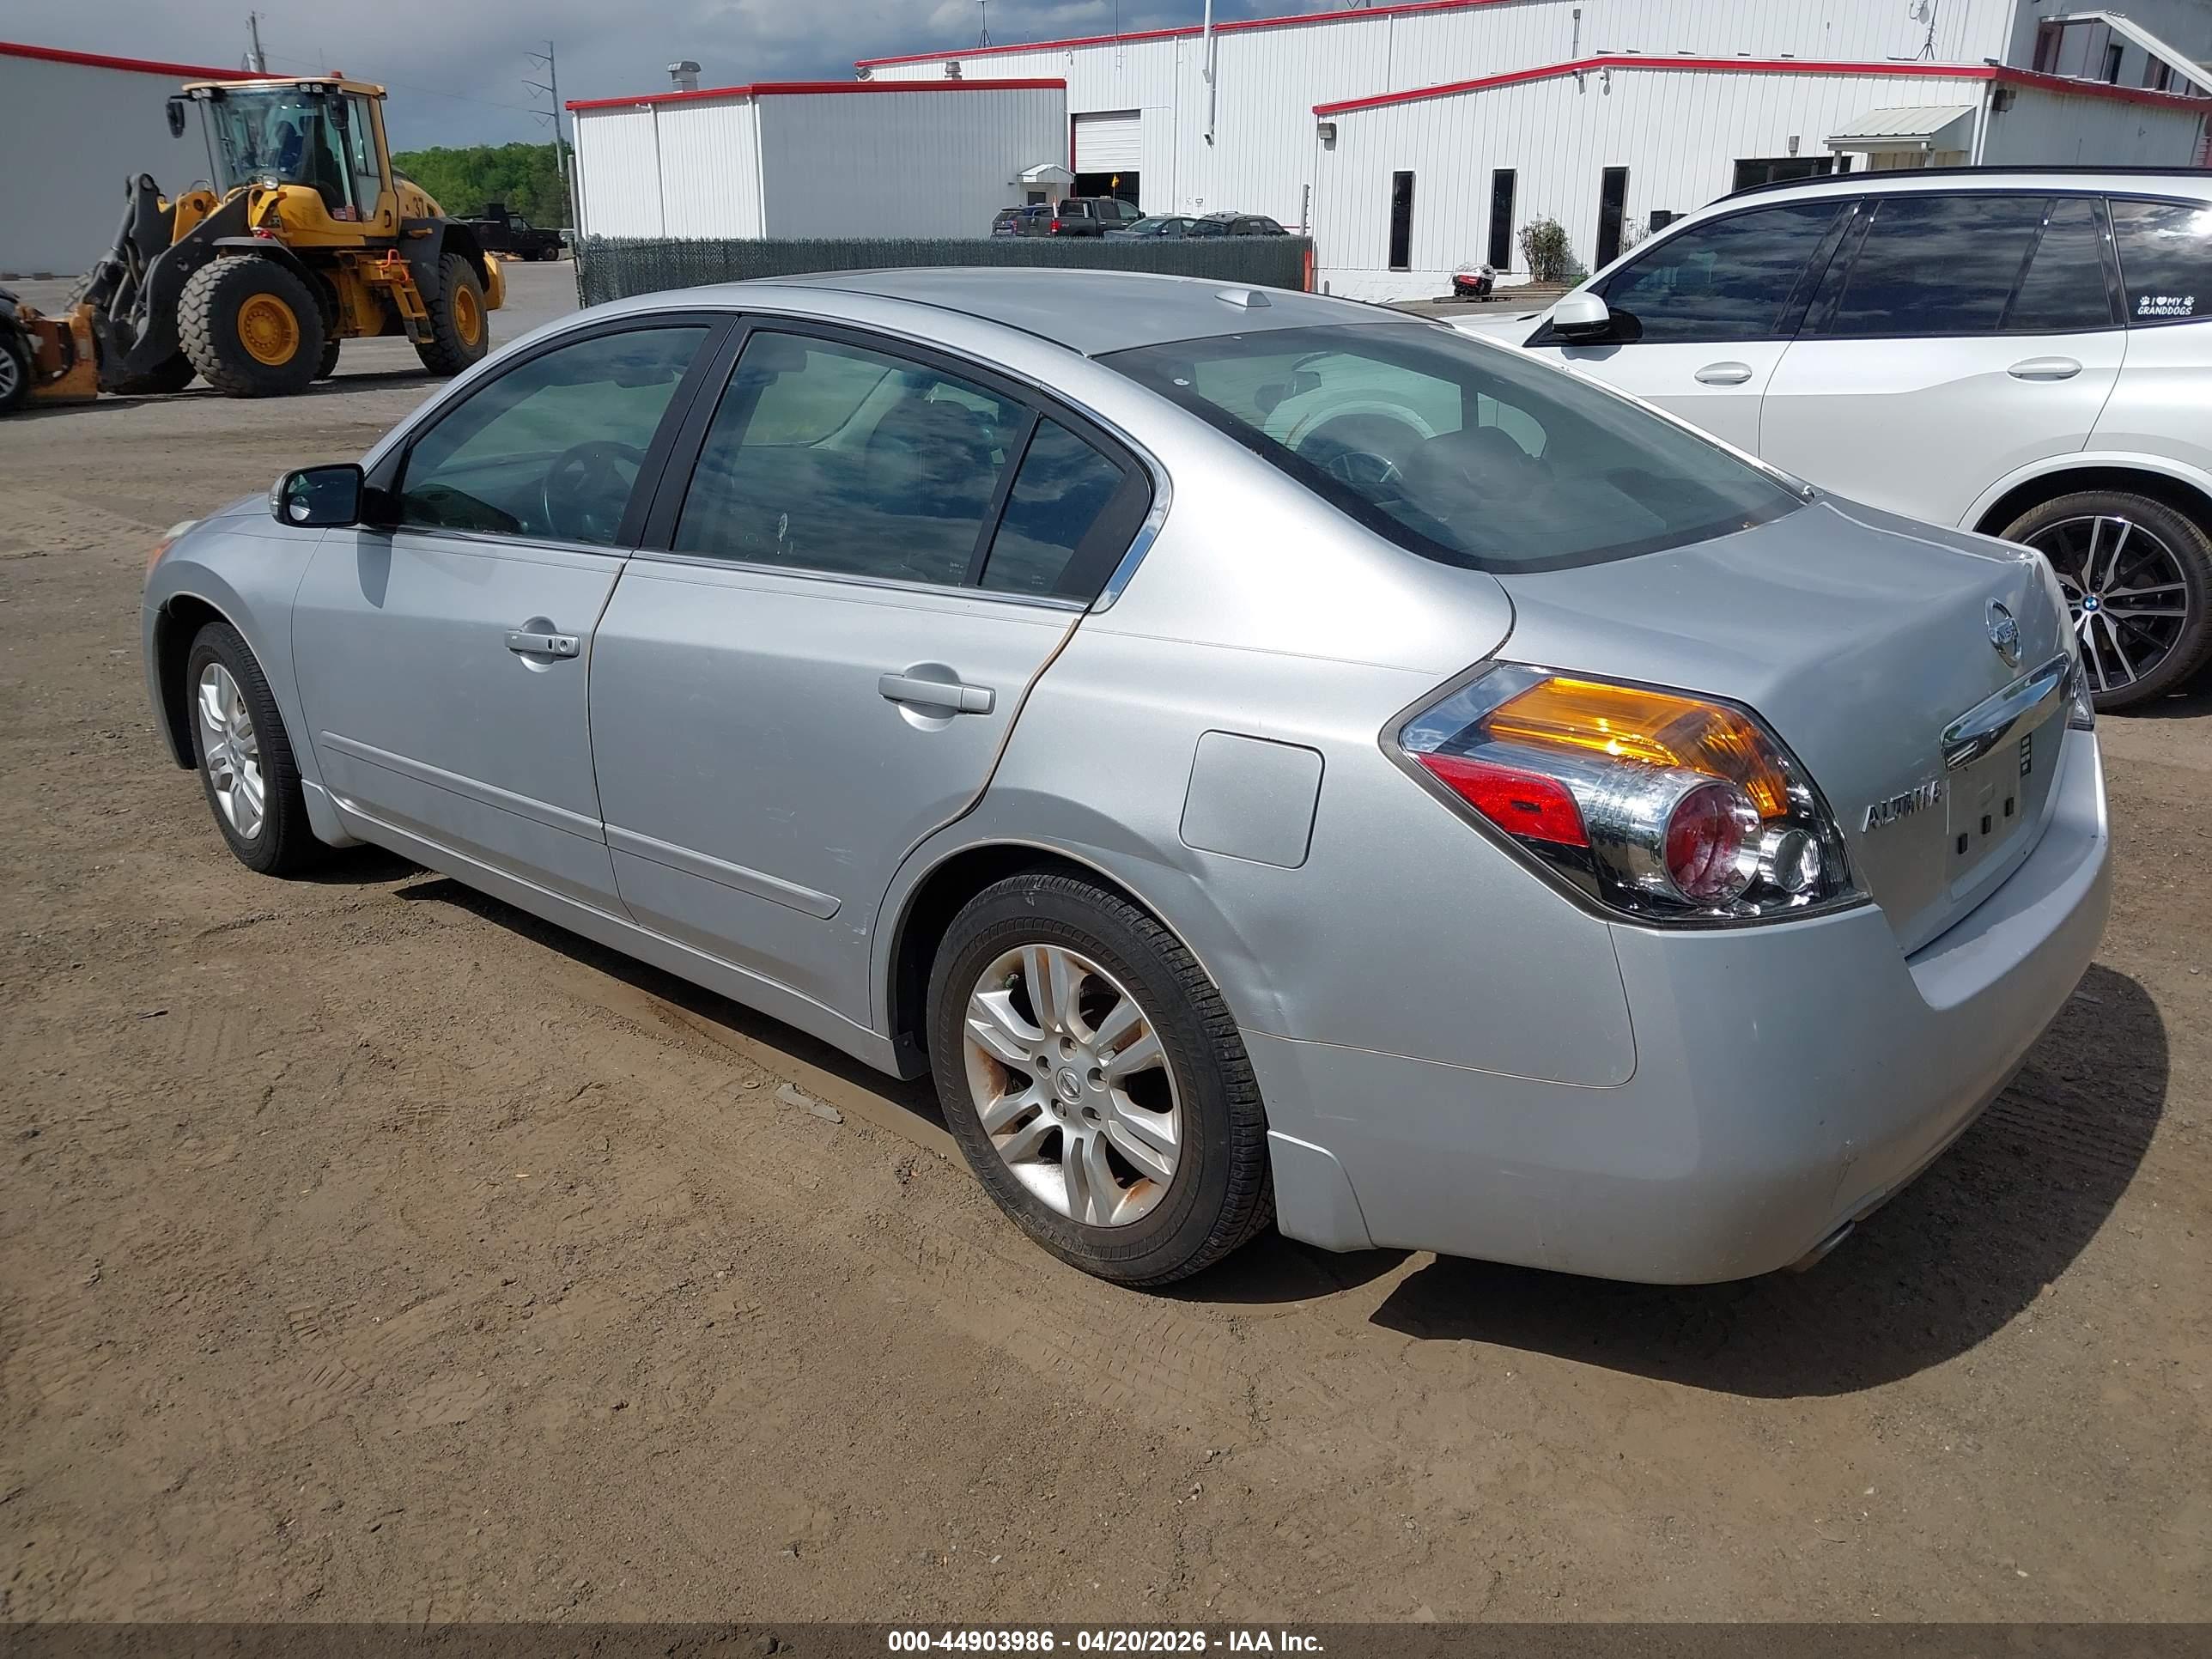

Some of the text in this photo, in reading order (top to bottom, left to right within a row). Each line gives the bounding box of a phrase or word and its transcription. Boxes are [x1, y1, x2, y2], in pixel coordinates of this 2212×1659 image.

[2166, 296, 2184, 306] MY
[2137, 306, 2193, 315] GRANDDOGS
[1860, 781, 1942, 833] ALTIMA
